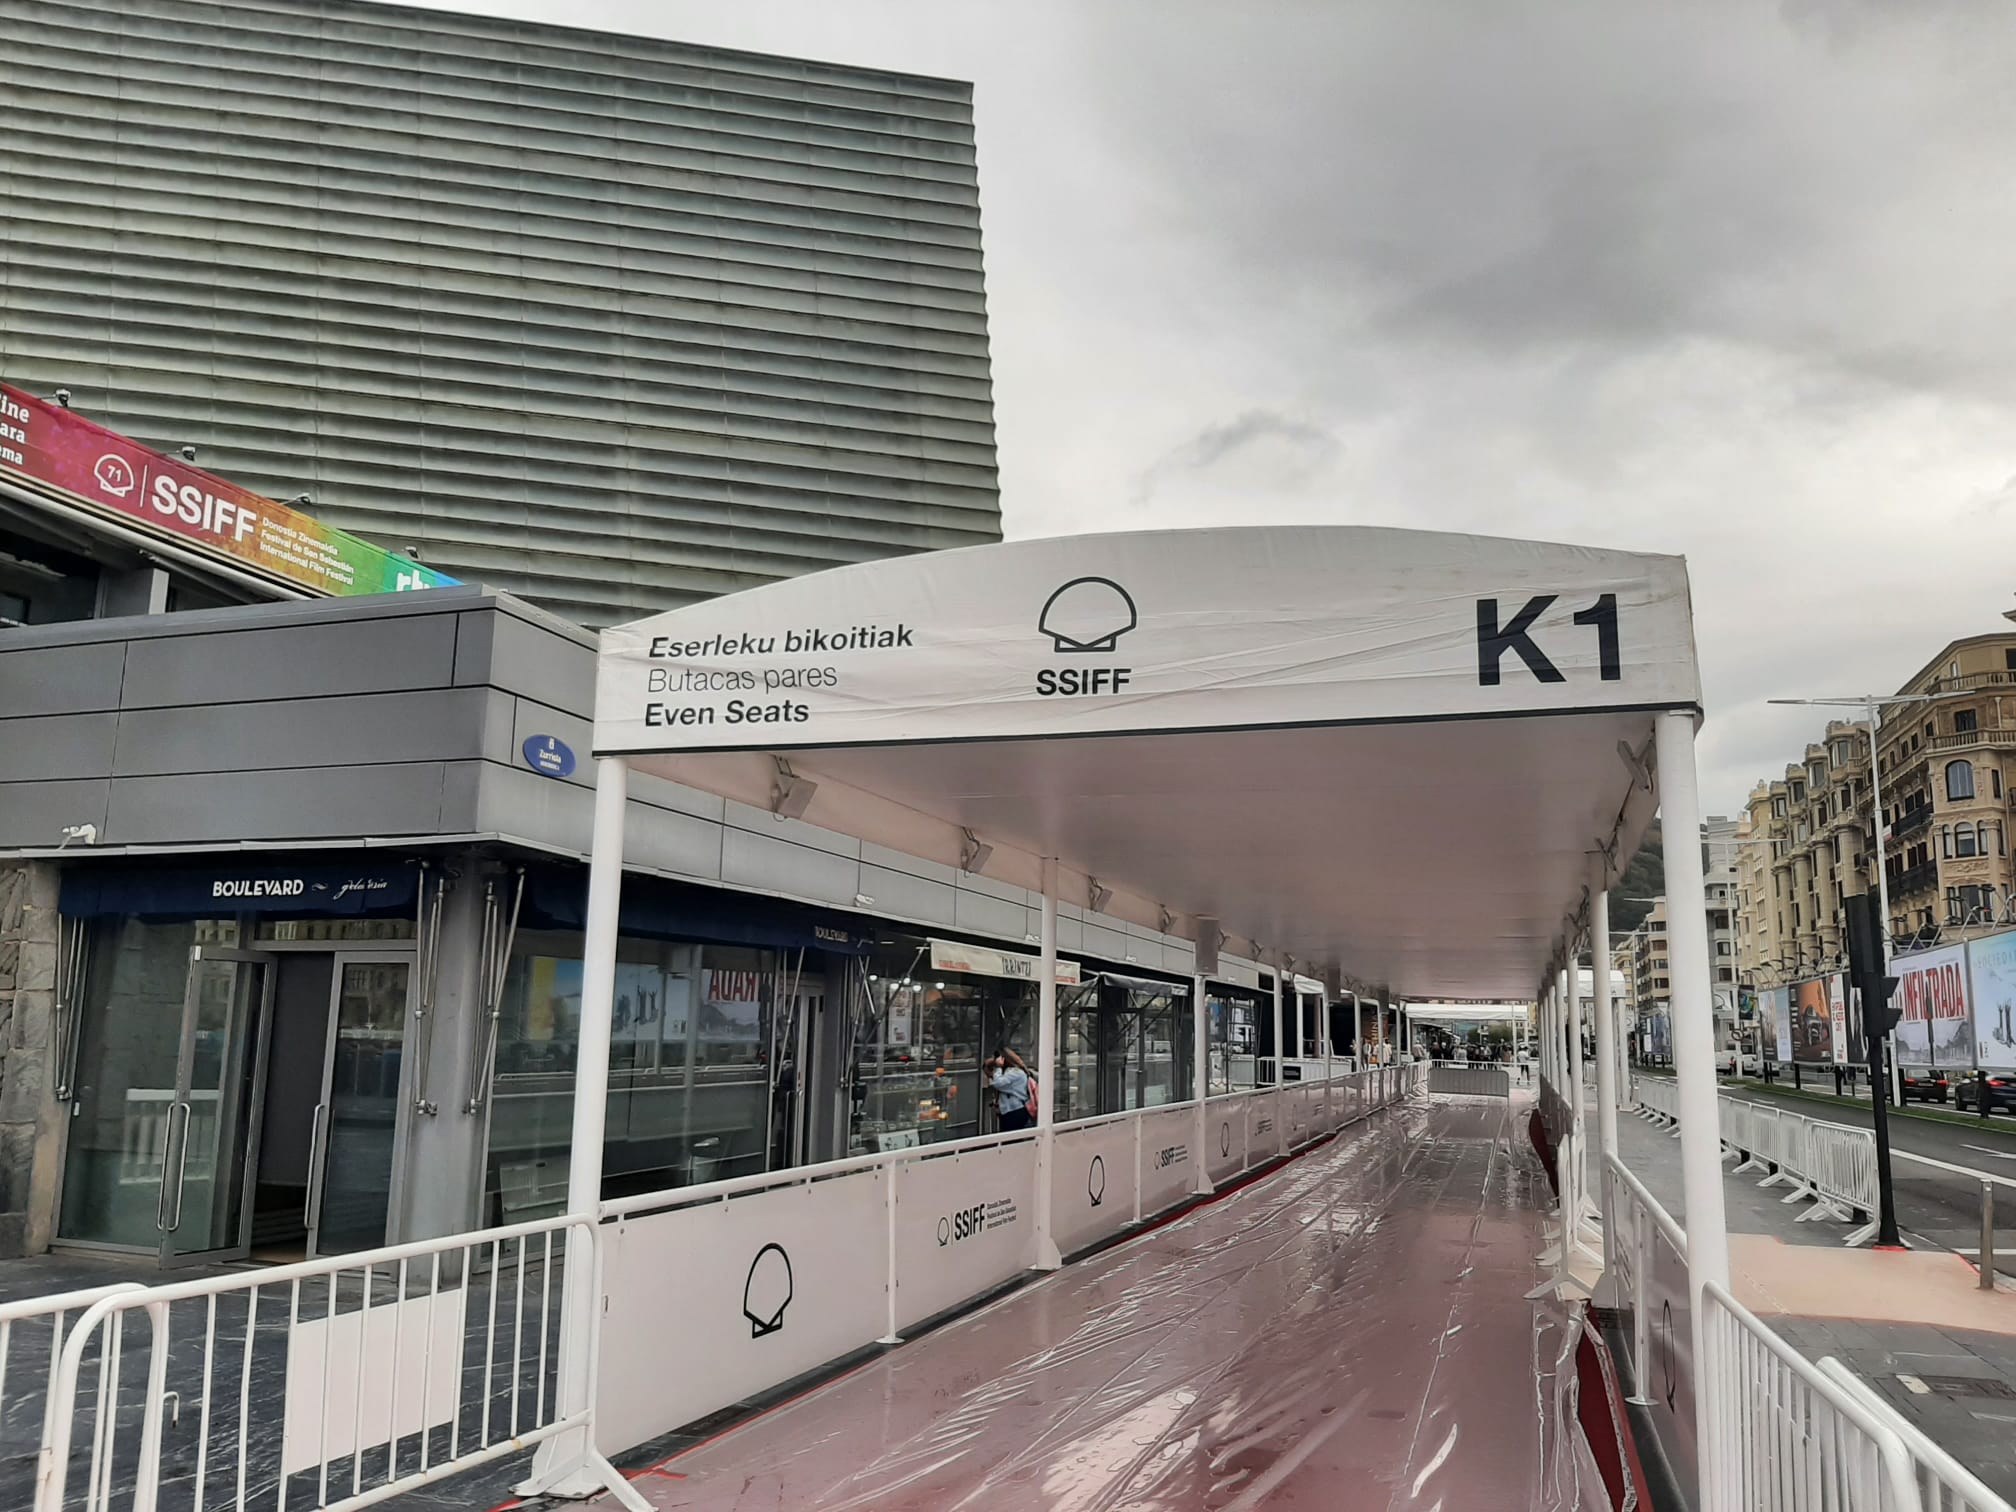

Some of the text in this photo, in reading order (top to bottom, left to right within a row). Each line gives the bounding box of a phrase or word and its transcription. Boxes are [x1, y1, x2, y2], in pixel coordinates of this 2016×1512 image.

[0, 394, 30, 423] ine
[108, 465, 121, 482] 71
[152, 475, 257, 542] SSIFF
[261, 529, 291, 549] Festival
[292, 542, 302, 553] de
[303, 547, 318, 560] San
[262, 516, 338, 556] Donostia Zinemaldia
[260, 541, 354, 586] International Film Festival
[649, 623, 914, 658] Eserleku bikoitiak
[1476, 593, 1621, 686] K1
[648, 667, 838, 694] Butacas pares
[1036, 668, 1132, 696] SSIFF
[645, 699, 809, 727] Even Seats
[212, 879, 304, 897] BOULEVARD
[1903, 962, 1965, 1021] INFILTRADA
[954, 1203, 985, 1241] SSIFF
